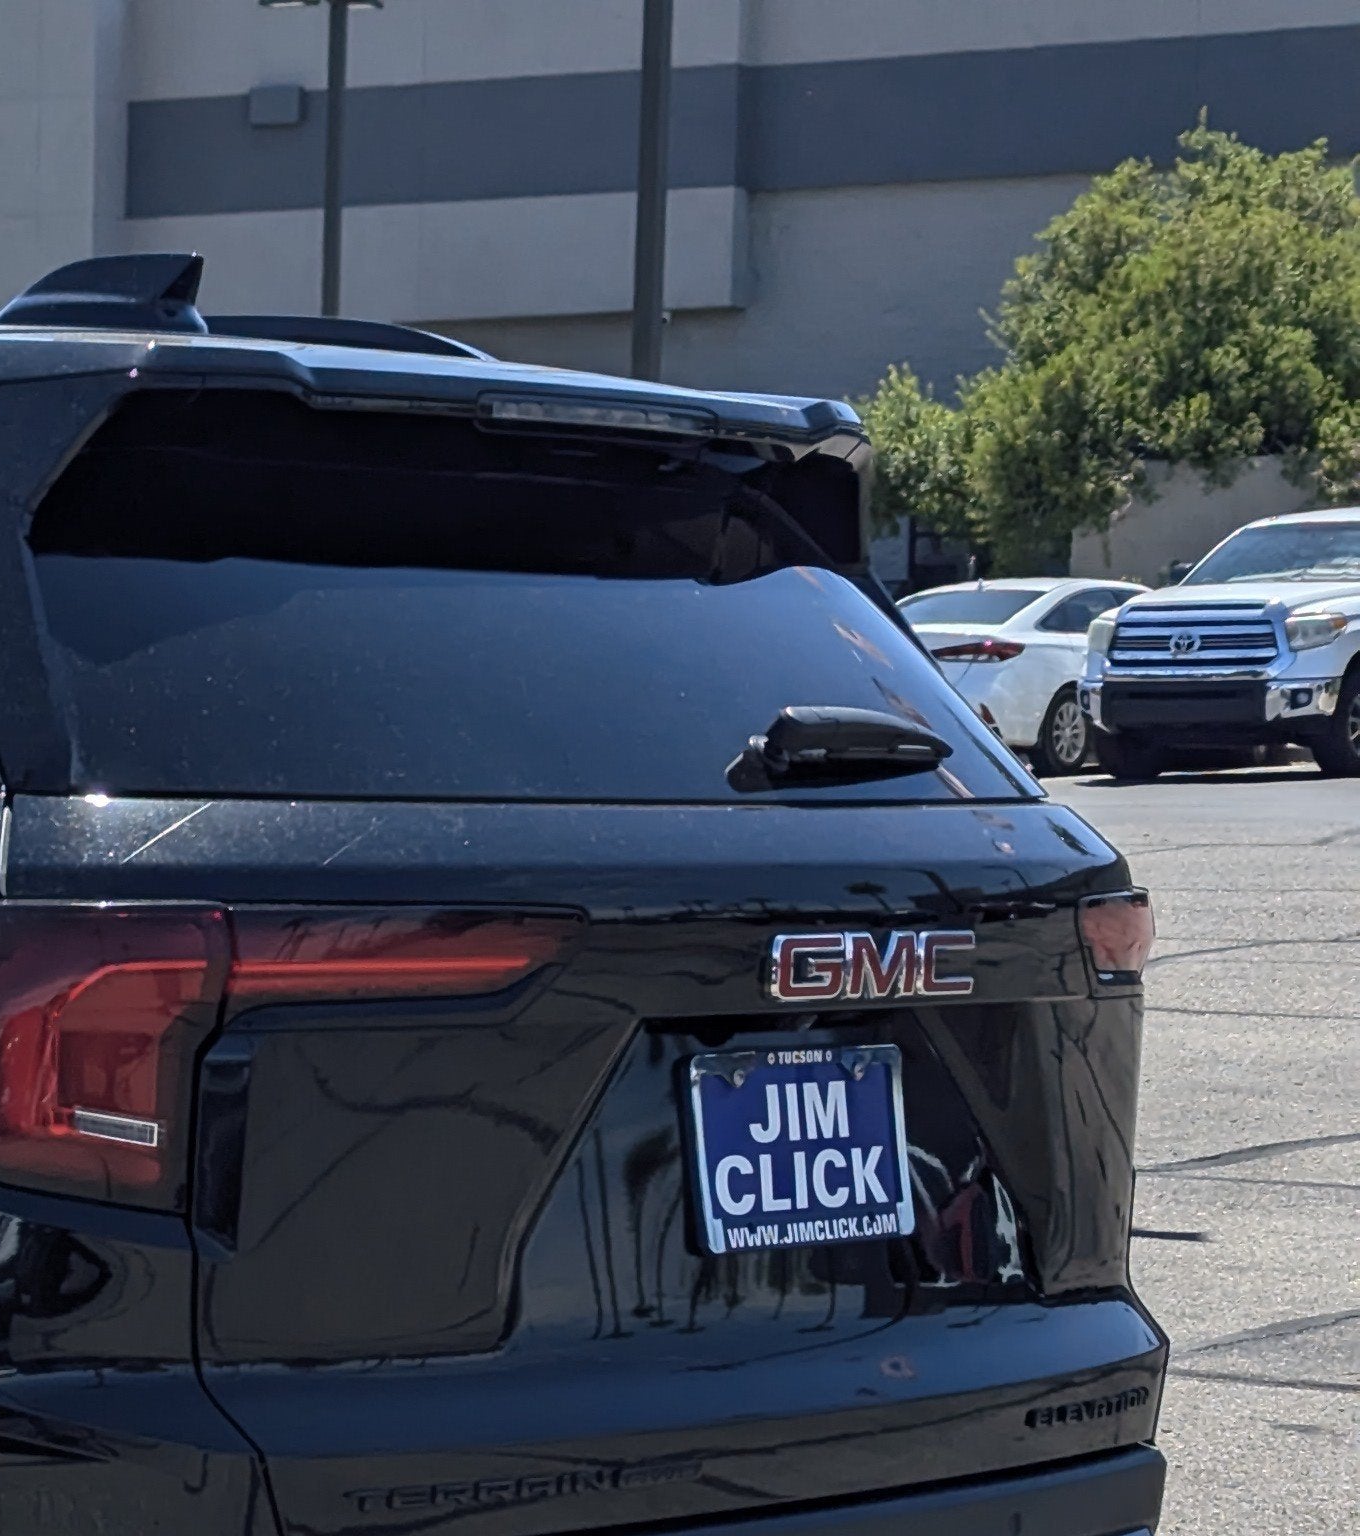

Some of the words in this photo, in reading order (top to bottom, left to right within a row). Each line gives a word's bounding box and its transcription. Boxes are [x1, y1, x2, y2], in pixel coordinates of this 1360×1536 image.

[770, 929, 976, 1001] GMC
[778, 1050, 823, 1064] TUCSON
[748, 1080, 850, 1143] JIM
[714, 1145, 890, 1216] CLICK
[726, 1213, 899, 1249] WWW.JIMCLICK.COM
